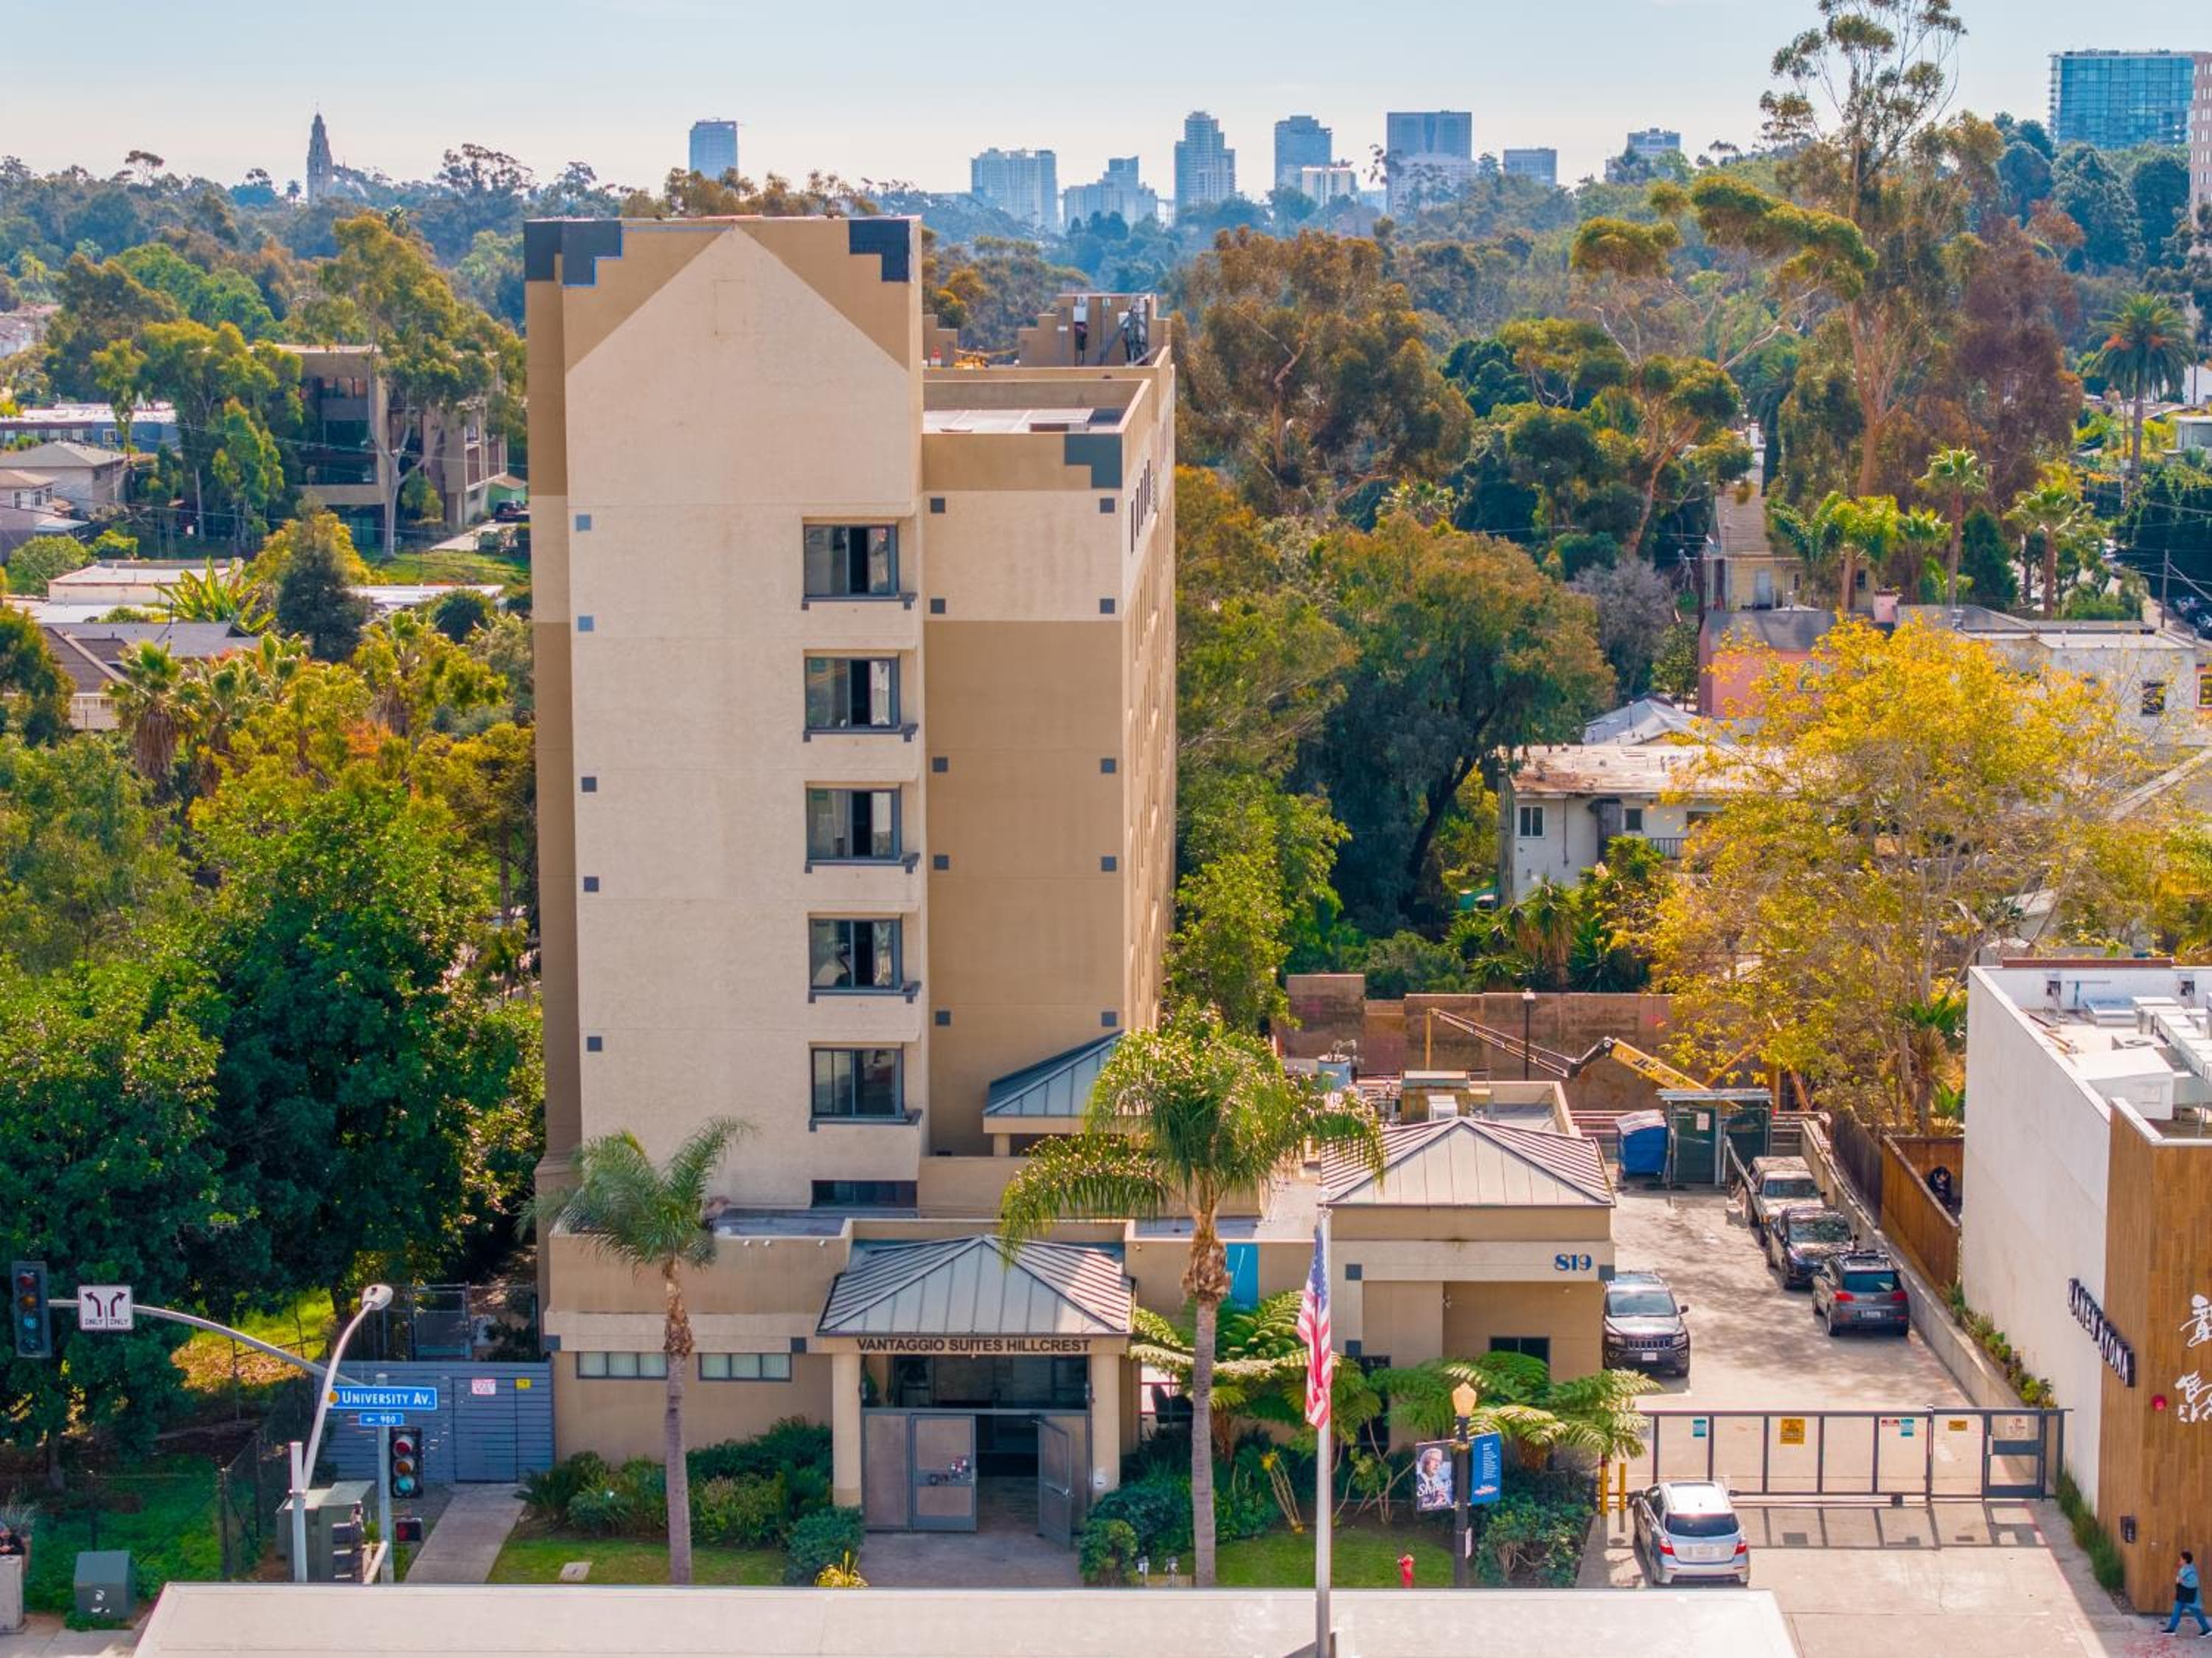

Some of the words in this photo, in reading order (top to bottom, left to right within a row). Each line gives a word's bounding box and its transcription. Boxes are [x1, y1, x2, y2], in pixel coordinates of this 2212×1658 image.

[1554, 1254, 1592, 1271] 819
[857, 1338, 945, 1352] VANTAGGIO
[948, 1338, 1003, 1353] SUITES
[1006, 1338, 1091, 1352] HILLCREST
[342, 1391, 409, 1404] UNIVERSITY
[413, 1392, 432, 1405] AV.
